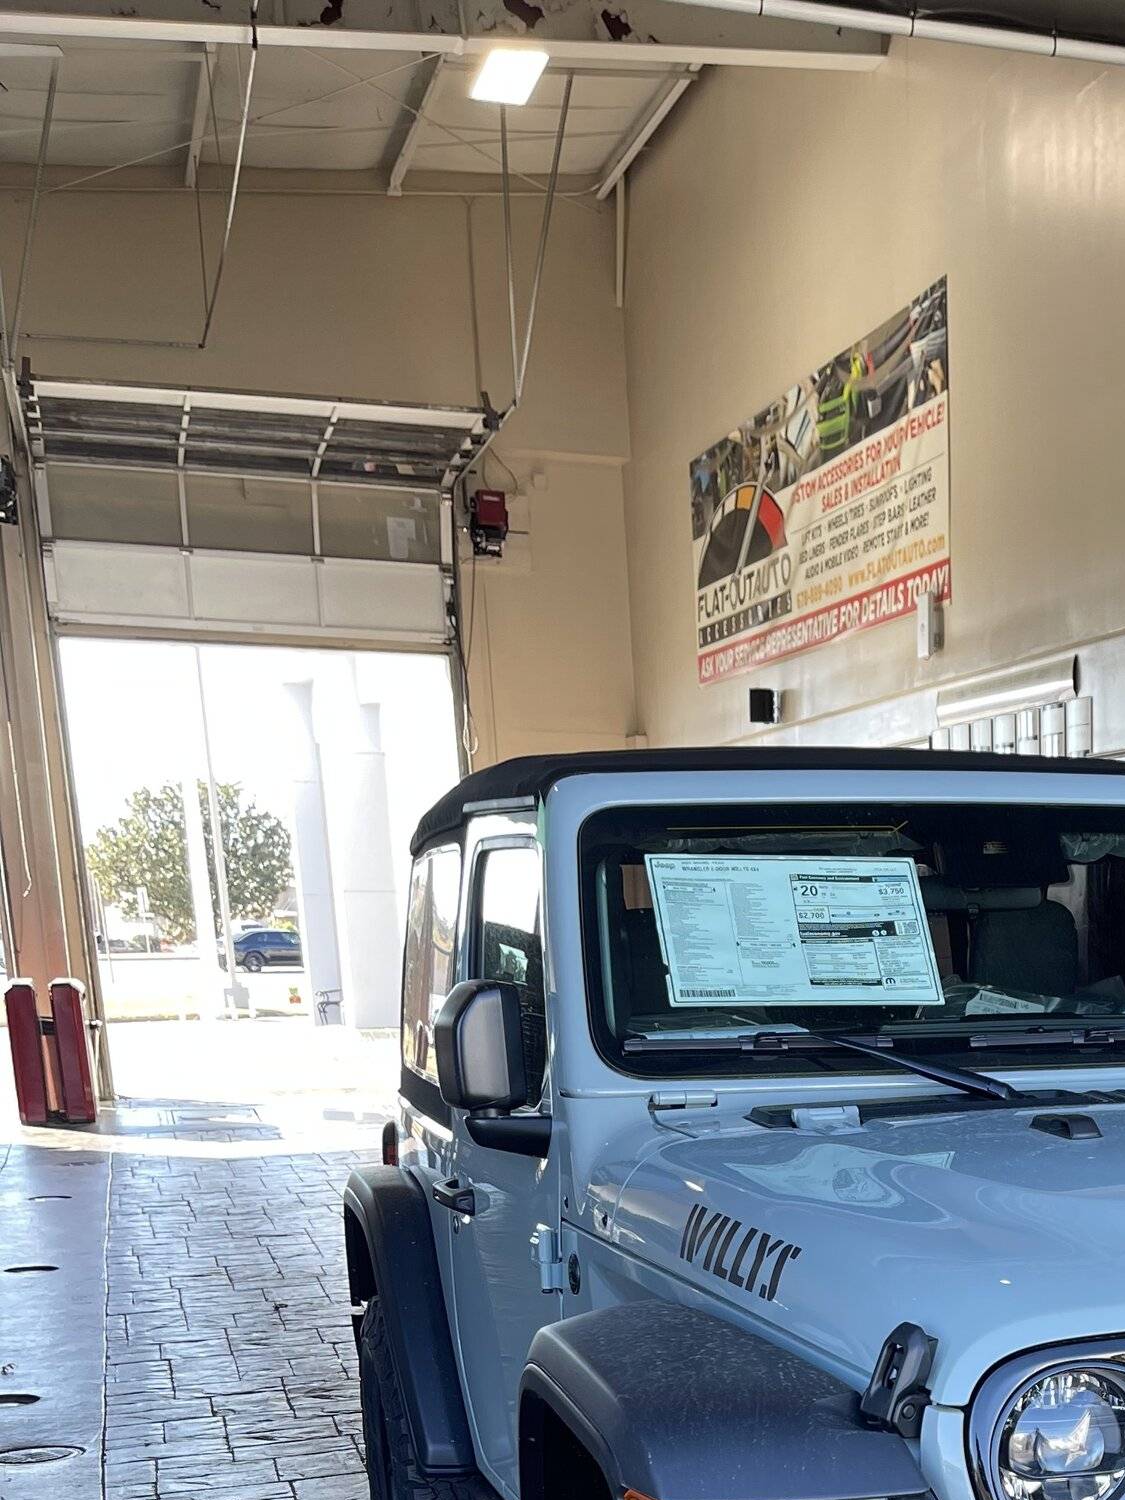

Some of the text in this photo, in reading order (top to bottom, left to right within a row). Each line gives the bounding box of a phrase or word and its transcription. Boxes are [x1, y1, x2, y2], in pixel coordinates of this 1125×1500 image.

[816, 449, 864, 491] ACCESSORIES
[866, 438, 882, 464] FOR
[904, 402, 944, 443] VEHICLE!
[821, 486, 843, 512] SALES
[850, 454, 901, 496] INSTALLATIN
[887, 503, 904, 523] BARS
[908, 487, 936, 513] LEATHER
[904, 468, 932, 495] LIGHTING
[862, 532, 885, 554] REMOTE
[714, 648, 734, 674] YOUR
[838, 600, 860, 630] FOR
[861, 583, 904, 622] DETAILS
[906, 566, 949, 607] TODAY!
[800, 885, 818, 896] 20
[679, 1203, 803, 1302] WILLYS
